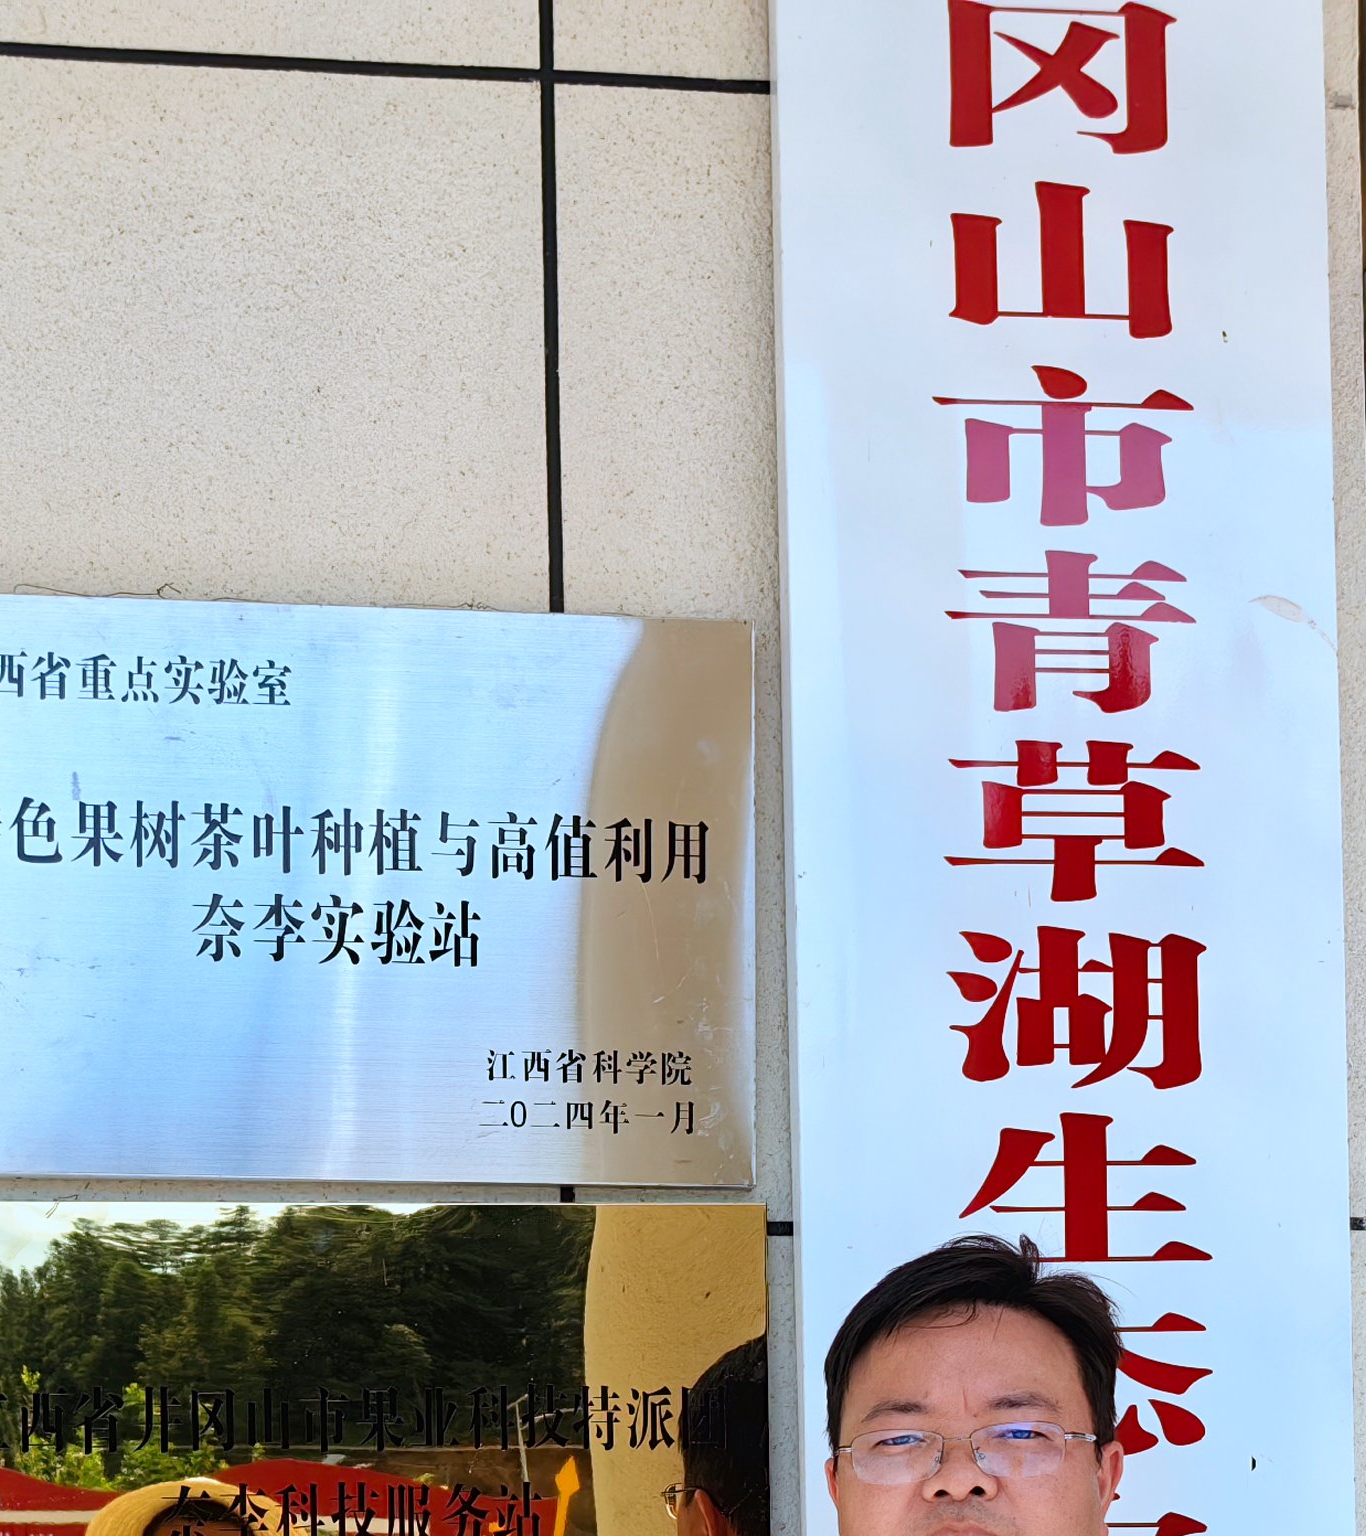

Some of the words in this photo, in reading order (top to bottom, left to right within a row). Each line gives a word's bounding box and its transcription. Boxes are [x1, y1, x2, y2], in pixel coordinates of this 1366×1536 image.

[192, 893, 481, 968] 奈李实验站
[486, 1049, 693, 1086] 江西省科学院
